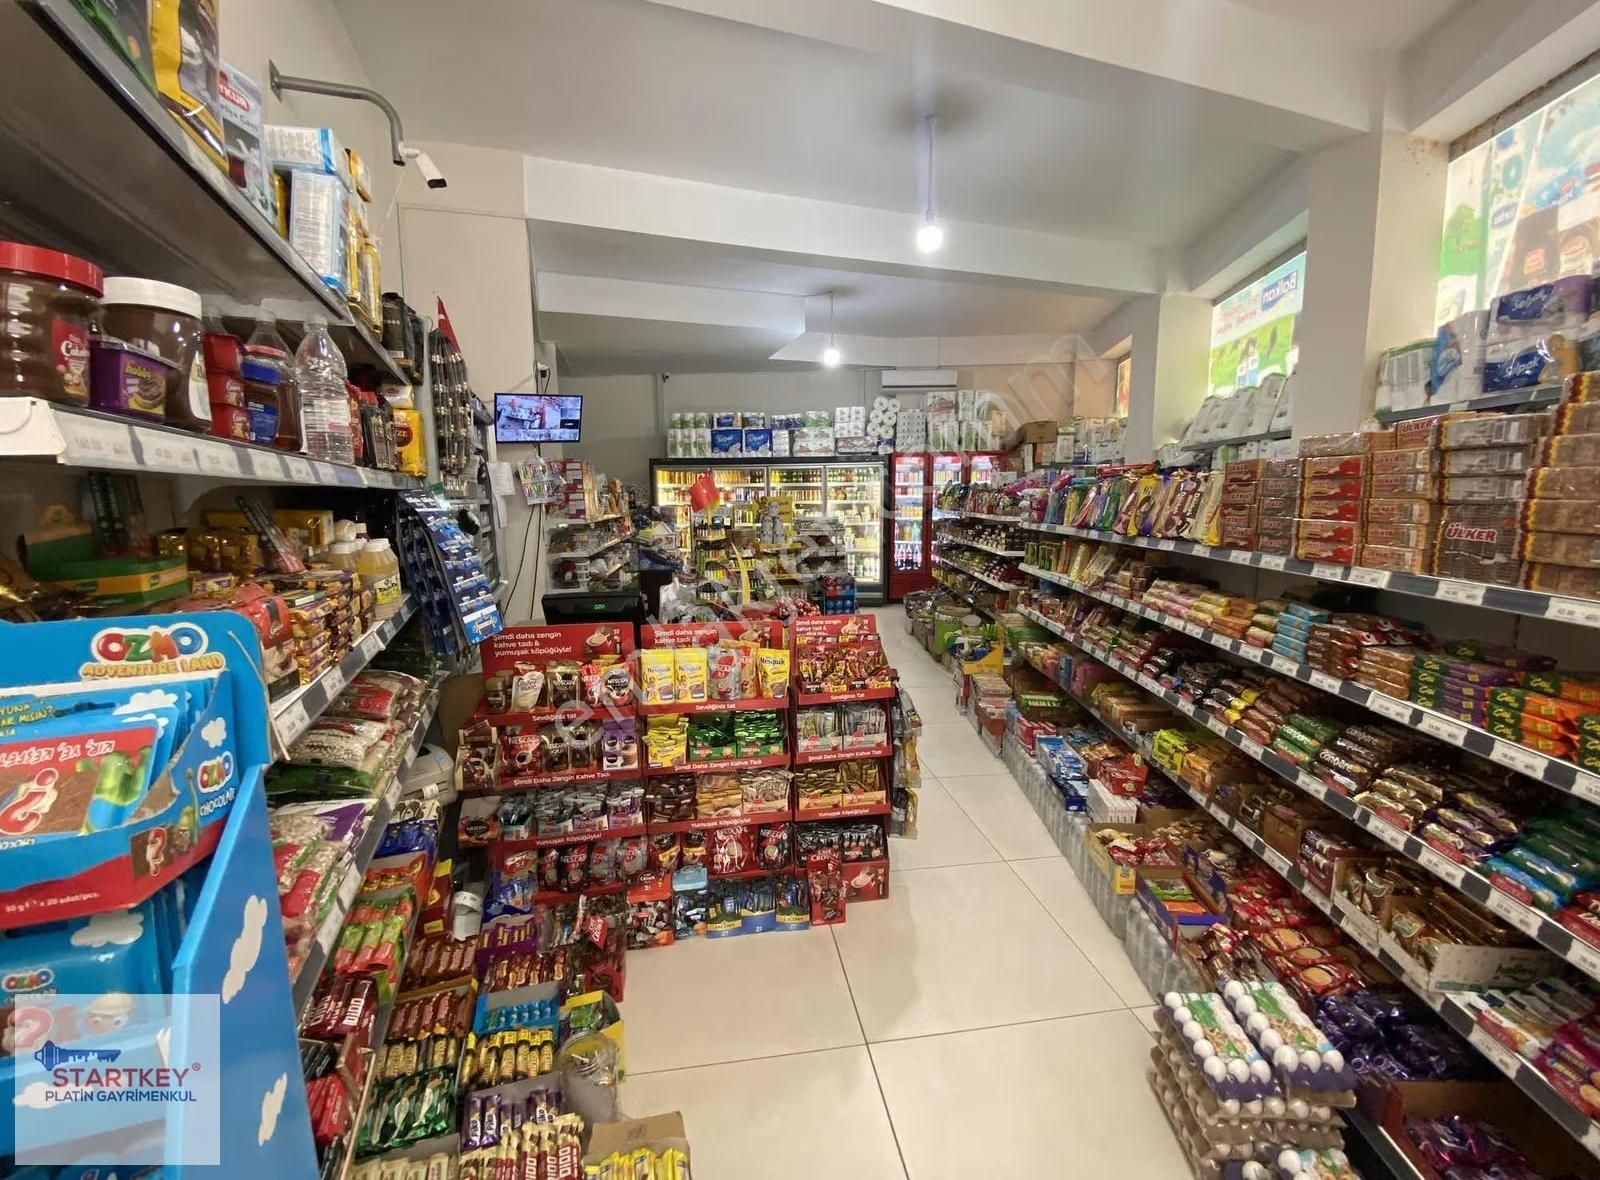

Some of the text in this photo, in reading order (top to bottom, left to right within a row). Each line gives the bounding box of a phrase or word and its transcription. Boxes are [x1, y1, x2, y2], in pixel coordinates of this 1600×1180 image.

[1447, 522, 1498, 543] ÜLKER
[493, 631, 562, 641] Şimdi daha zengin
[654, 629, 675, 638] Şimdi
[97, 627, 204, 663] OZMO
[493, 641, 517, 649] kahve
[518, 640, 534, 648] tadı
[494, 646, 572, 658] yumuşak köpüğüyle!
[82, 654, 224, 677] ADVENTURE LAND
[760, 656, 785, 665] Nesquik
[552, 775, 575, 783] Zengin
